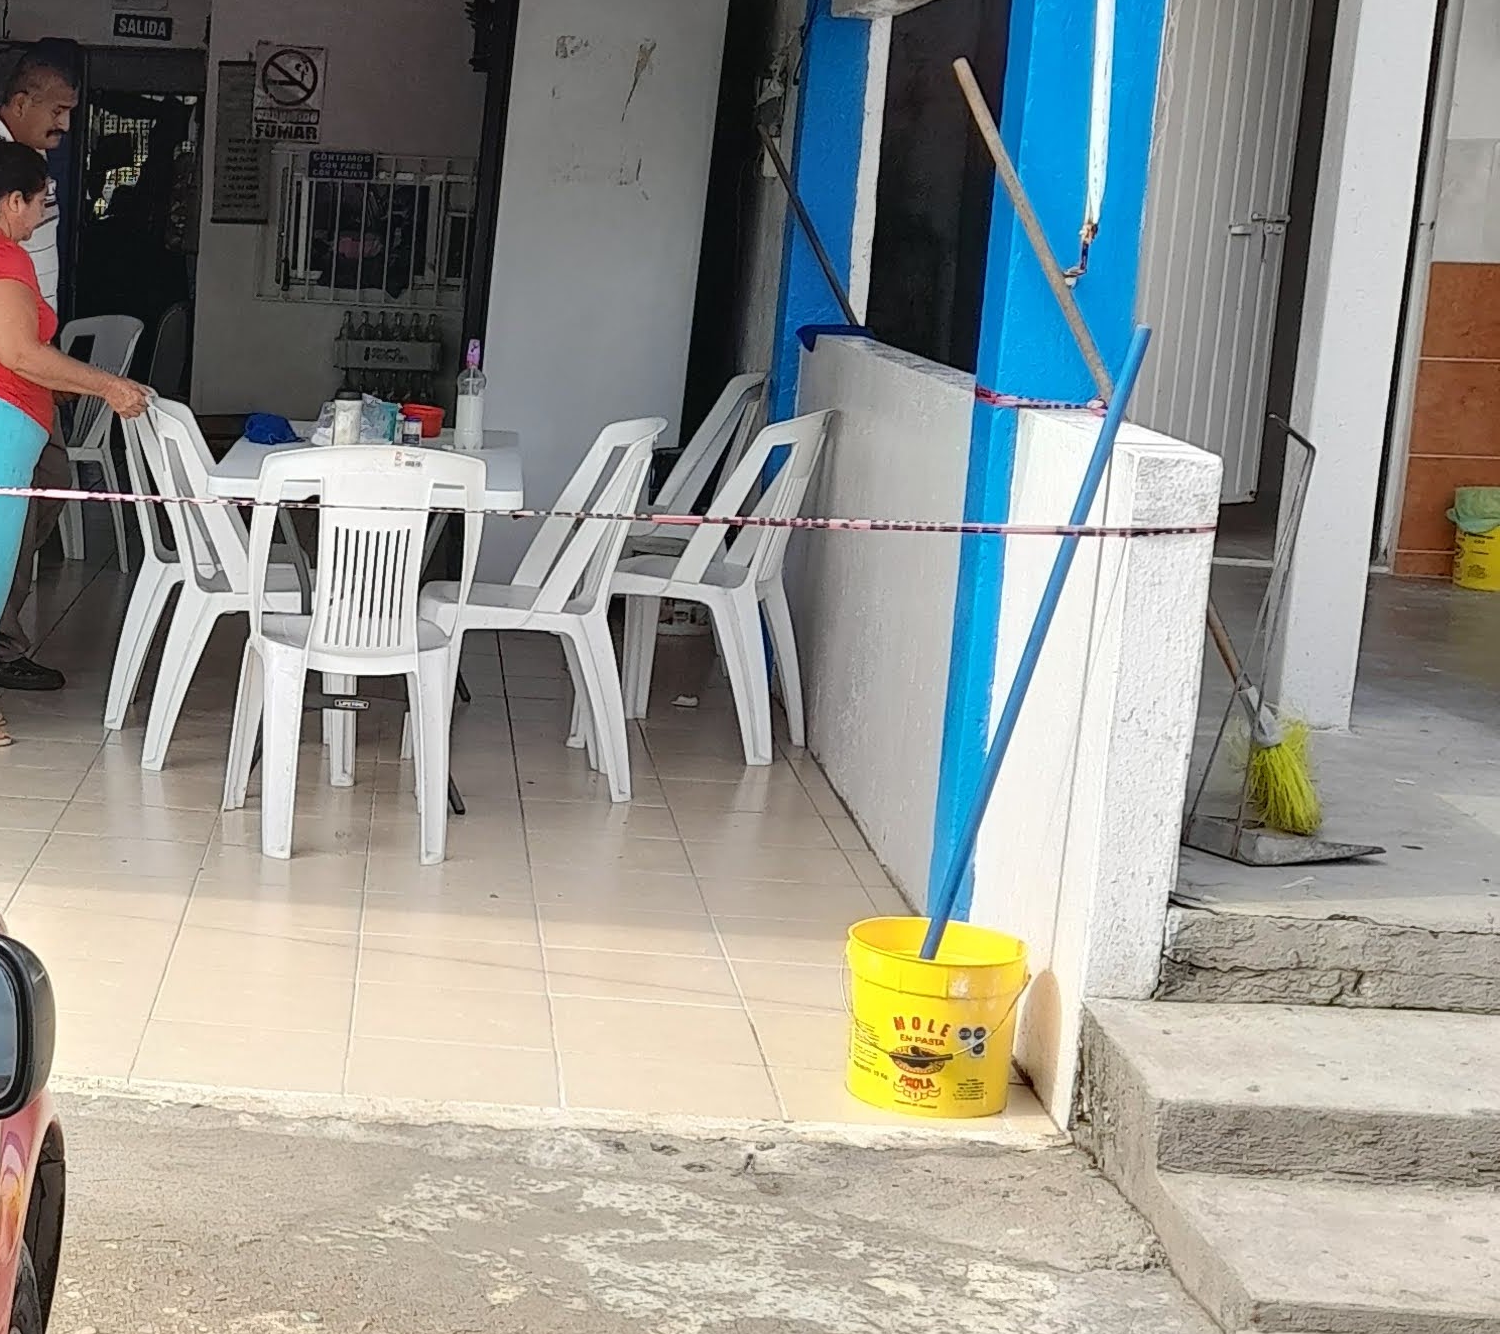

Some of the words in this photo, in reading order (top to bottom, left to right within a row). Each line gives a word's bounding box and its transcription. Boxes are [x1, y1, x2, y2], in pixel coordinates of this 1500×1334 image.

[118, 17, 167, 37] SALIDA
[255, 124, 318, 140] FUMAR
[313, 153, 371, 164] CONTAMOS
[893, 1015, 952, 1038] MOLE
